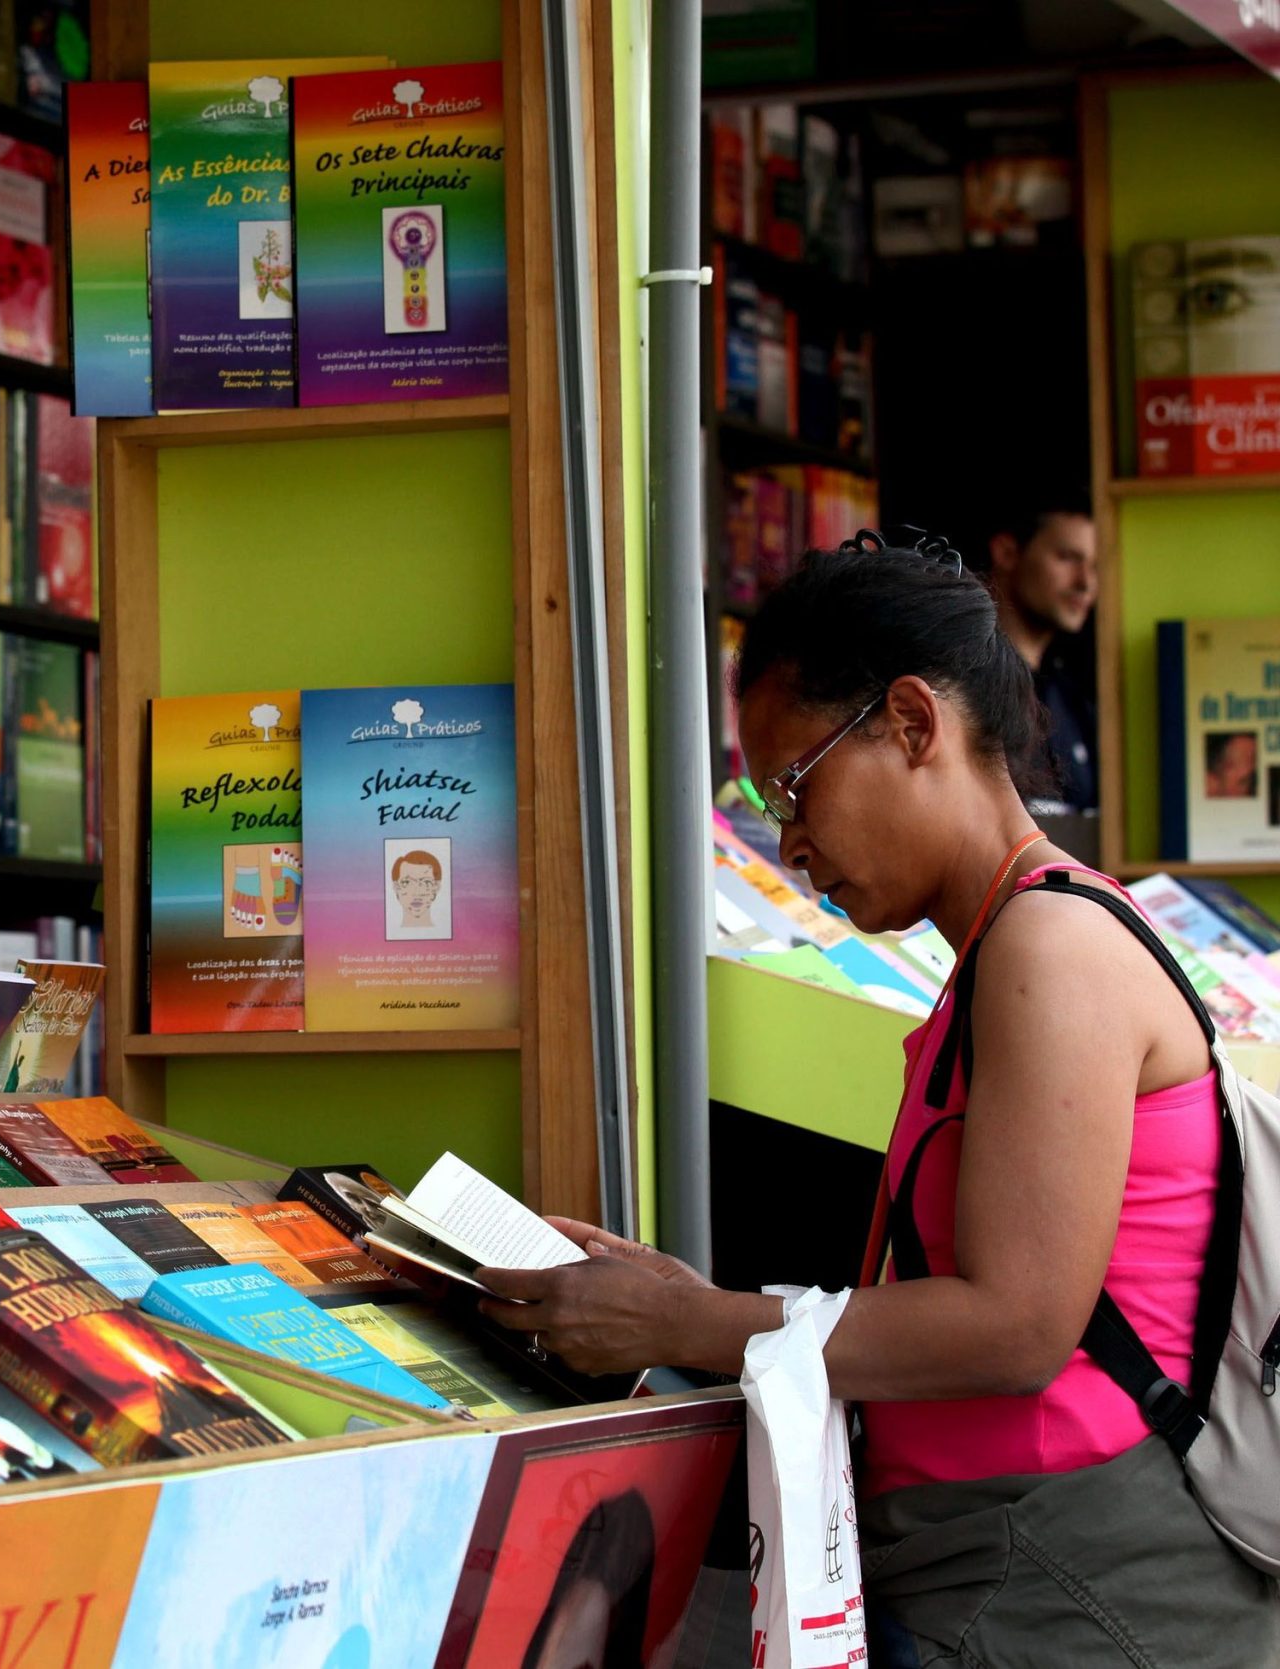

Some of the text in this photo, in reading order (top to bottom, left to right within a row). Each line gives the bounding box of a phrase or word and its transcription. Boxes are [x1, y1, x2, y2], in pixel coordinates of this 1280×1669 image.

[201, 100, 257, 120] Guias
[352, 96, 482, 123] Guias Práticos
[316, 136, 505, 172] Os Sete Chakras
[84, 164, 101, 183] A
[158, 165, 185, 185] As
[351, 168, 471, 200] Principais
[207, 185, 233, 207] do
[241, 186, 270, 204] Dr.
[217, 332, 233, 341] das
[173, 346, 198, 354] nome
[415, 357, 437, 367] vital
[209, 726, 257, 747] Guias
[351, 717, 483, 742] Guias Práticos
[360, 766, 477, 801] Shiatsu
[378, 797, 460, 827] Facial
[187, 959, 238, 971] Localização
[239, 959, 255, 967] das
[257, 958, 280, 967] áreas
[198, 973, 214, 981] sua
[216, 971, 249, 983] ligação
[250, 972, 268, 980] com
[270, 969, 300, 981] órgãos
[101, 1208, 128, 1221] Joseph
[180, 1210, 205, 1223] Joseph
[256, 1212, 278, 1223] Joseph
[296, 1185, 353, 1234] HERMÓGENES
[19, 1246, 74, 1284] RON
[328, 1260, 358, 1273] VIVER
[232, 1273, 278, 1292] CAPRA
[0, 1278, 126, 1332] HUBBARD
[302, 1577, 329, 1597] Ramos
[298, 1601, 326, 1622] Ramos
